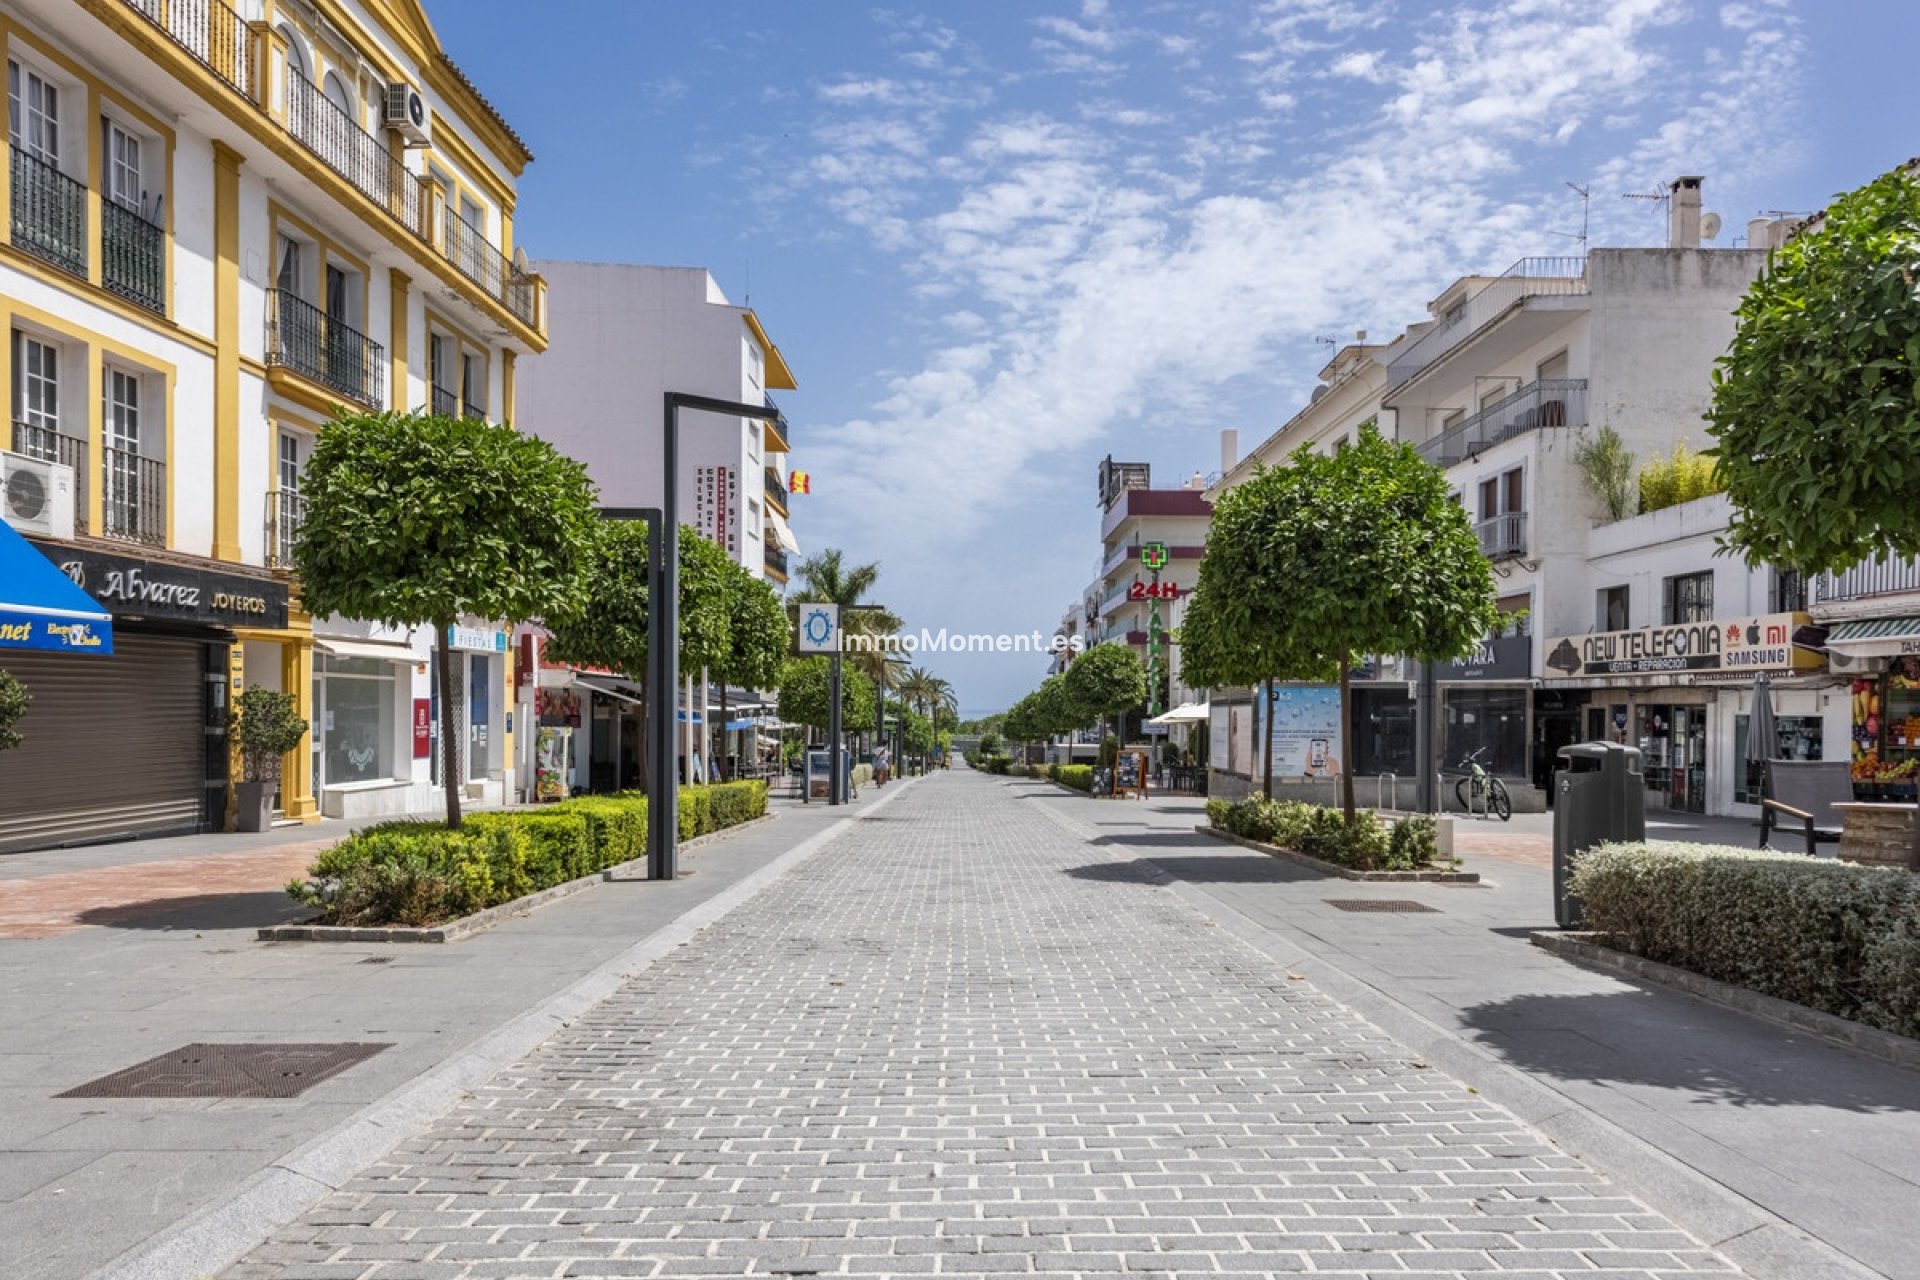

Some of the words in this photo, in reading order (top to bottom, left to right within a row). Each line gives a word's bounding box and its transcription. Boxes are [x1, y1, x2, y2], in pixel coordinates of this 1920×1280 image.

[97, 568, 201, 606] Alvarez
[210, 592, 267, 614] JOYEROS
[1131, 581, 1178, 598] 24H
[1584, 635, 1617, 661] NEW
[1619, 625, 1720, 659] TELEFONIA
[1726, 648, 1785, 666] SAMSUNG
